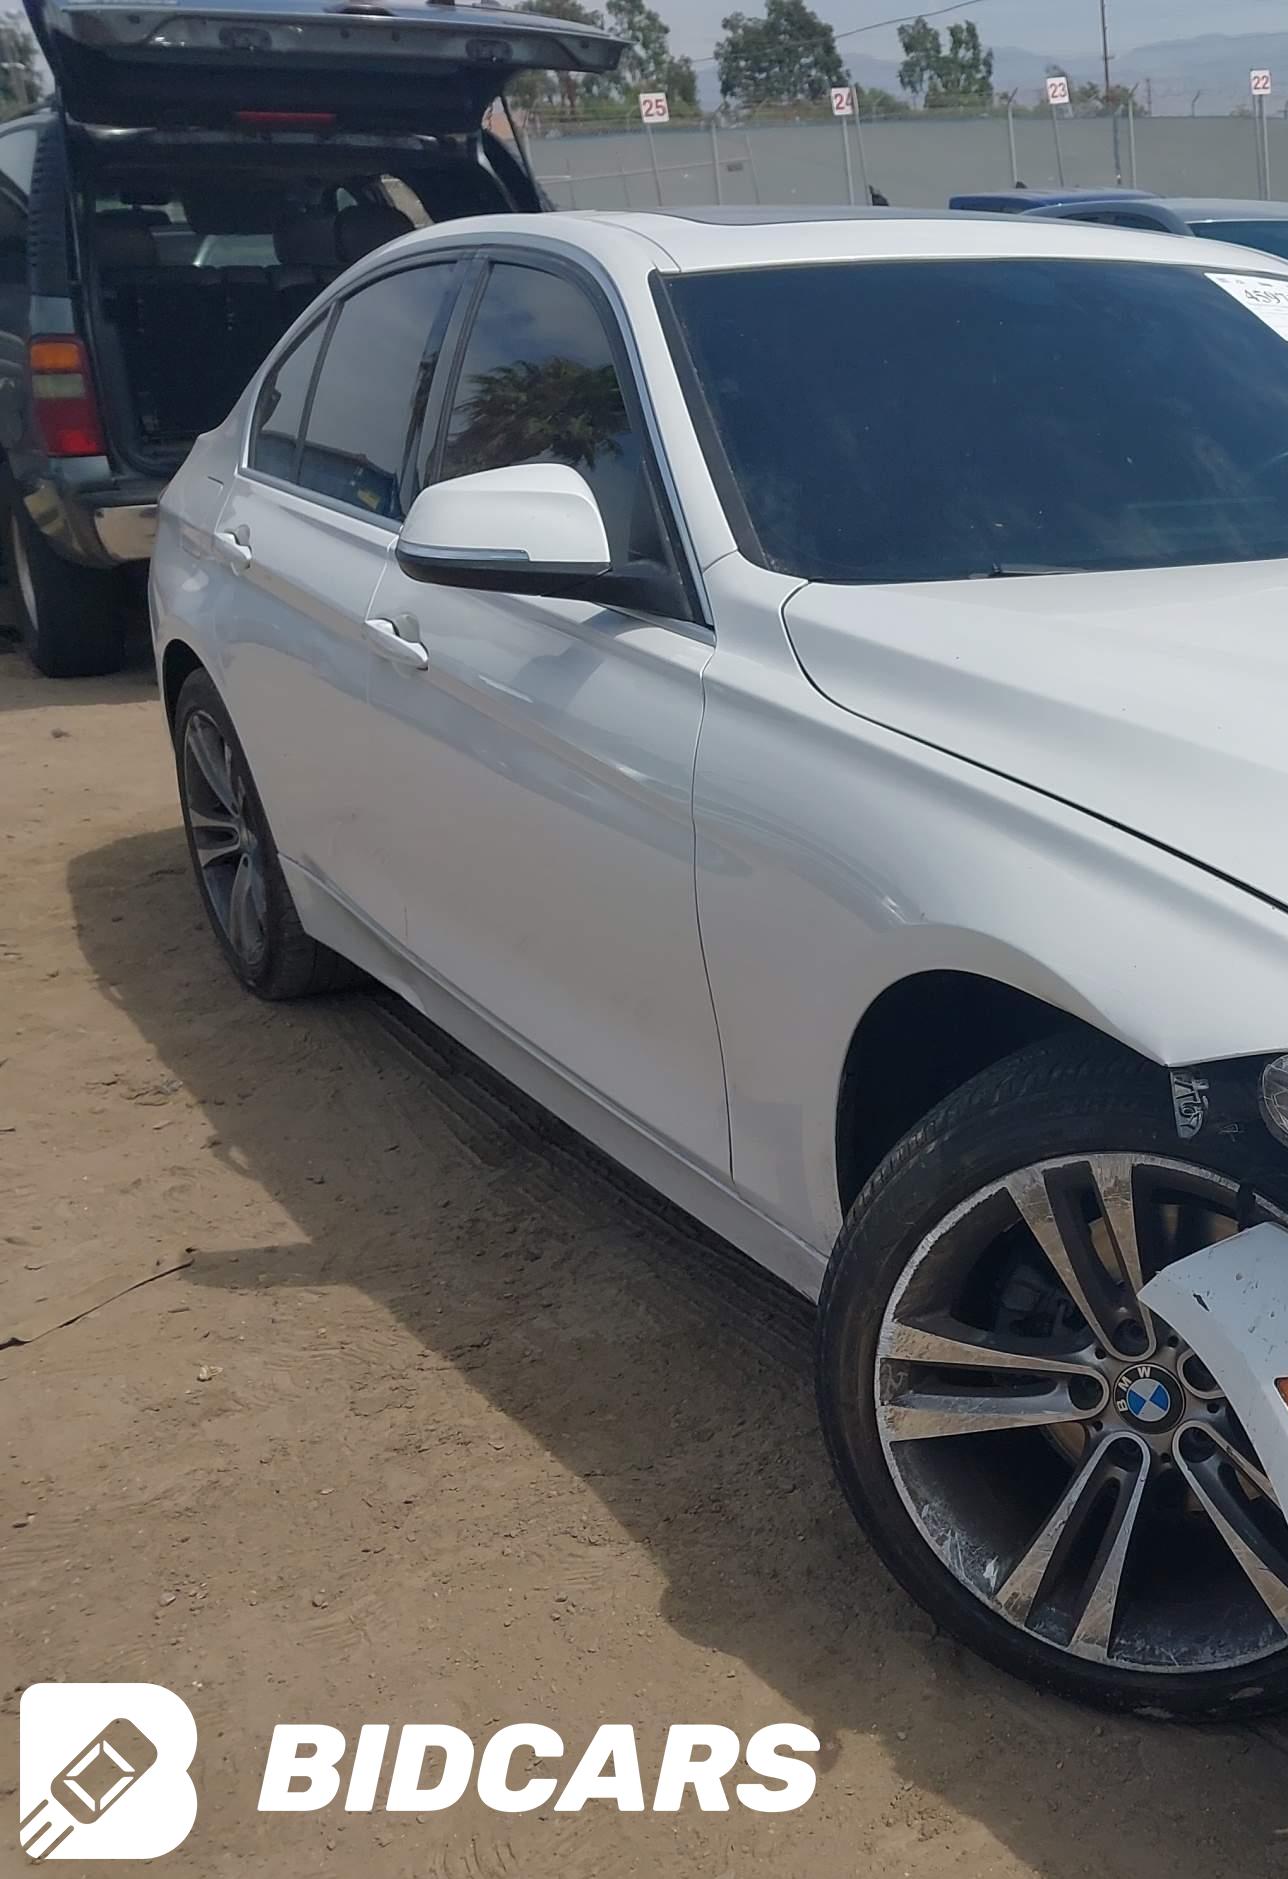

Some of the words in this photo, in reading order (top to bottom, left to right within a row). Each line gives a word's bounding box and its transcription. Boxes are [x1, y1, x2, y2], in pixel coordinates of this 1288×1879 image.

[1050, 82, 1067, 98] 23
[1252, 75, 1269, 90] 22
[642, 99, 667, 117] 25
[1116, 1366, 1151, 1412] BMW
